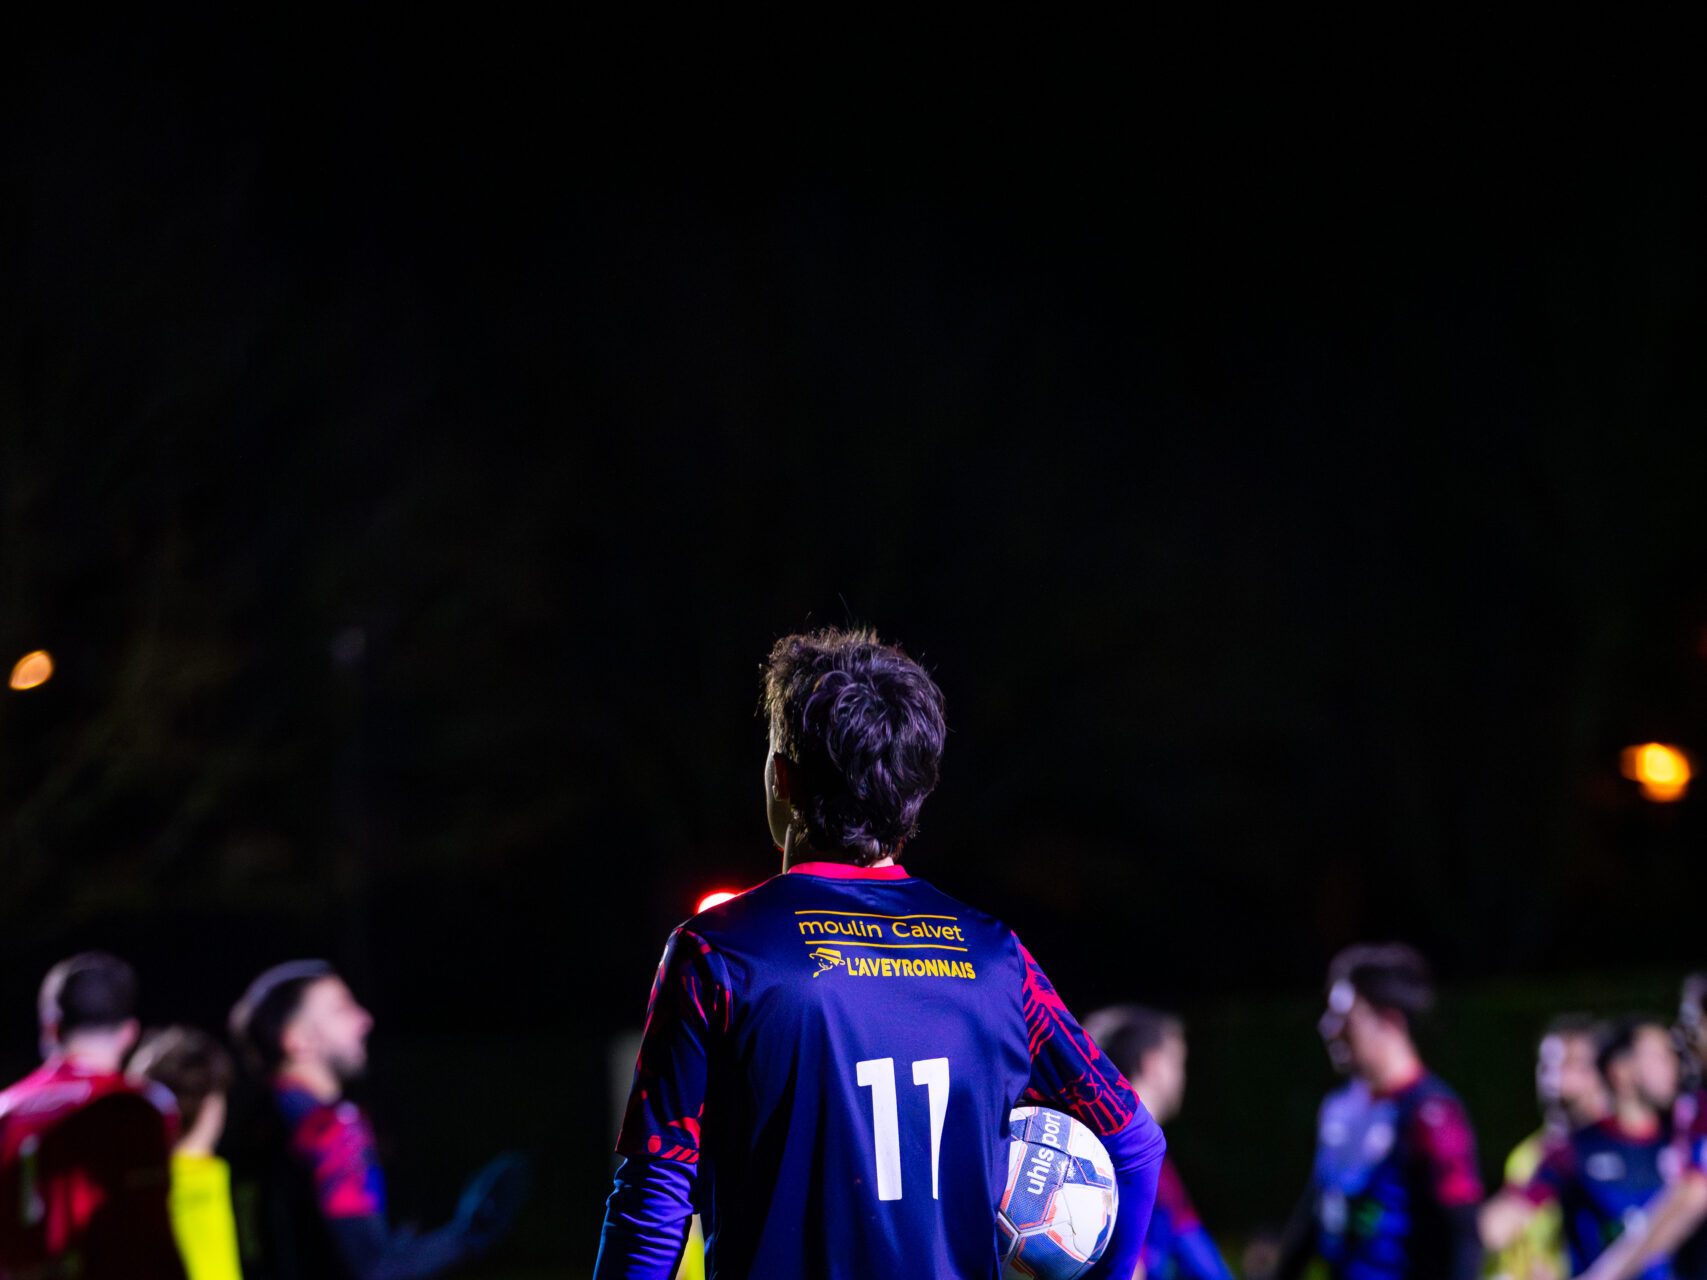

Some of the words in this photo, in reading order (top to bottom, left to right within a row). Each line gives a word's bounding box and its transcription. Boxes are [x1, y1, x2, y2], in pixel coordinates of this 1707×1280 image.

[798, 920, 882, 938] moulin
[891, 921, 965, 942] Calvet
[846, 957, 976, 979] L'AVEYRONNAIS
[856, 1057, 950, 1200] 11
[1027, 1111, 1061, 1195] uhlsport
